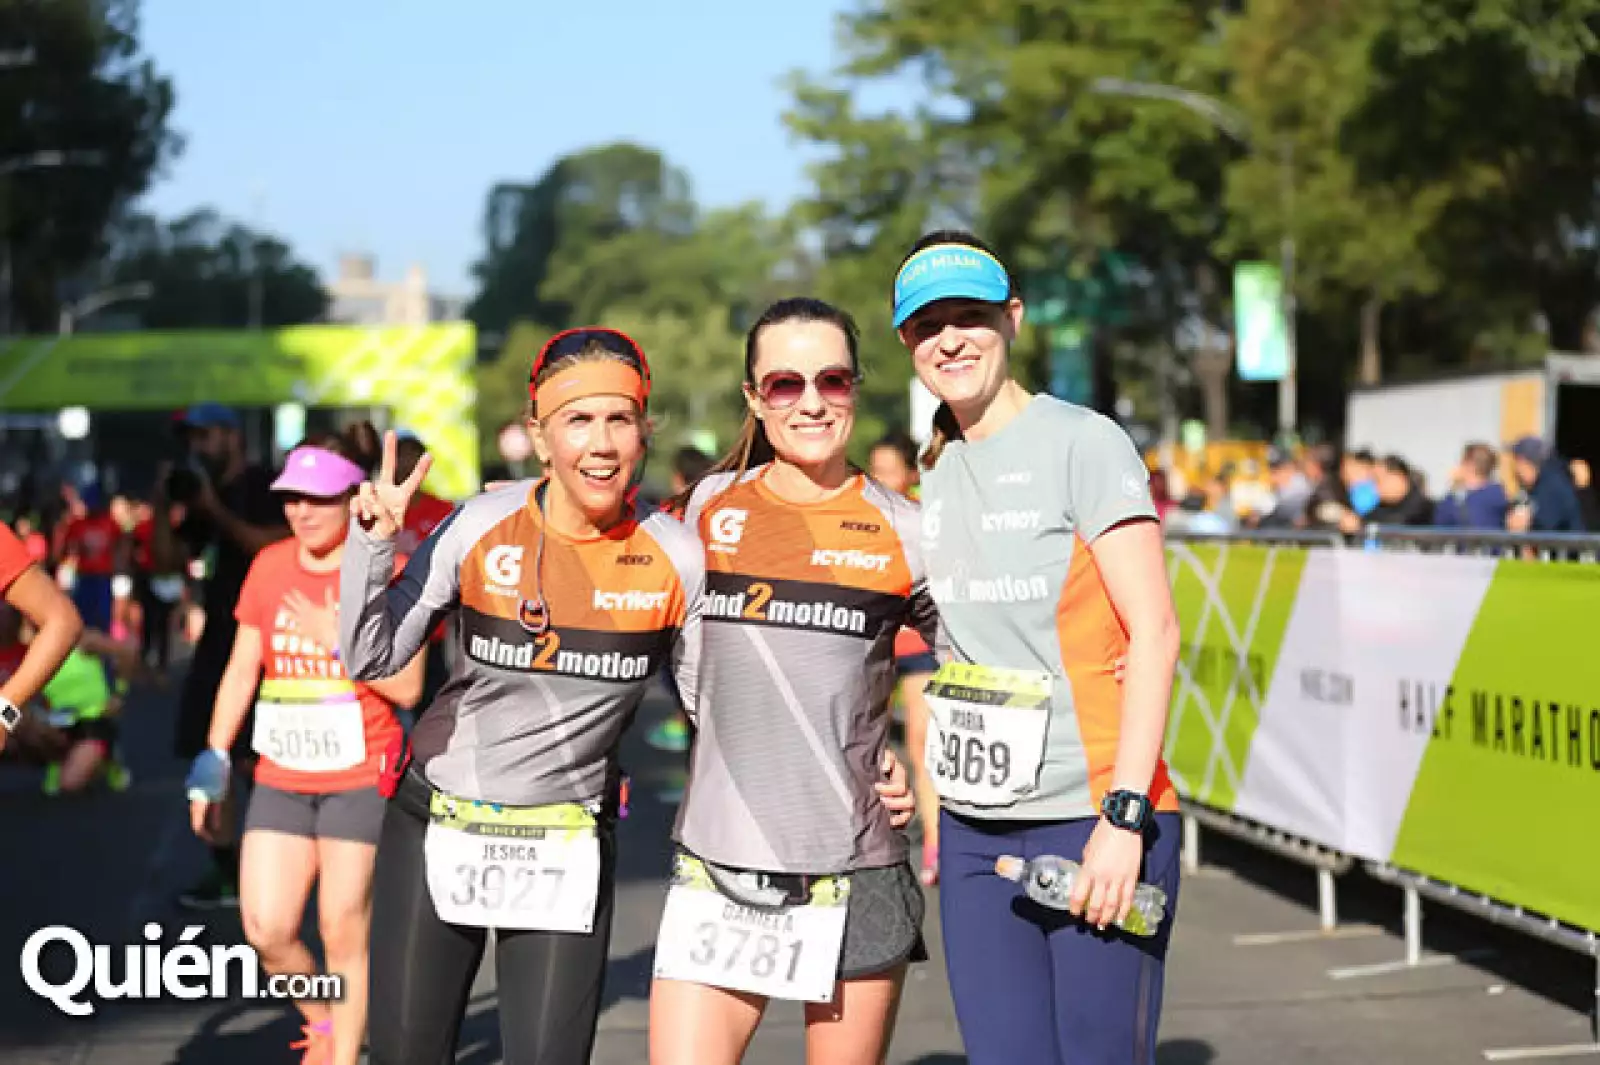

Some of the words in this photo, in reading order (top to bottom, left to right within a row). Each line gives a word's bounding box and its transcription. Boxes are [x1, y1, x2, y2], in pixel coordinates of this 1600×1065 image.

[710, 508, 749, 544] G
[484, 545, 524, 586] G
[1399, 678, 1454, 740] HALF
[269, 728, 342, 759] 5056
[482, 844, 538, 862] JESICA
[451, 864, 566, 911] 3927
[689, 921, 803, 982] 3781
